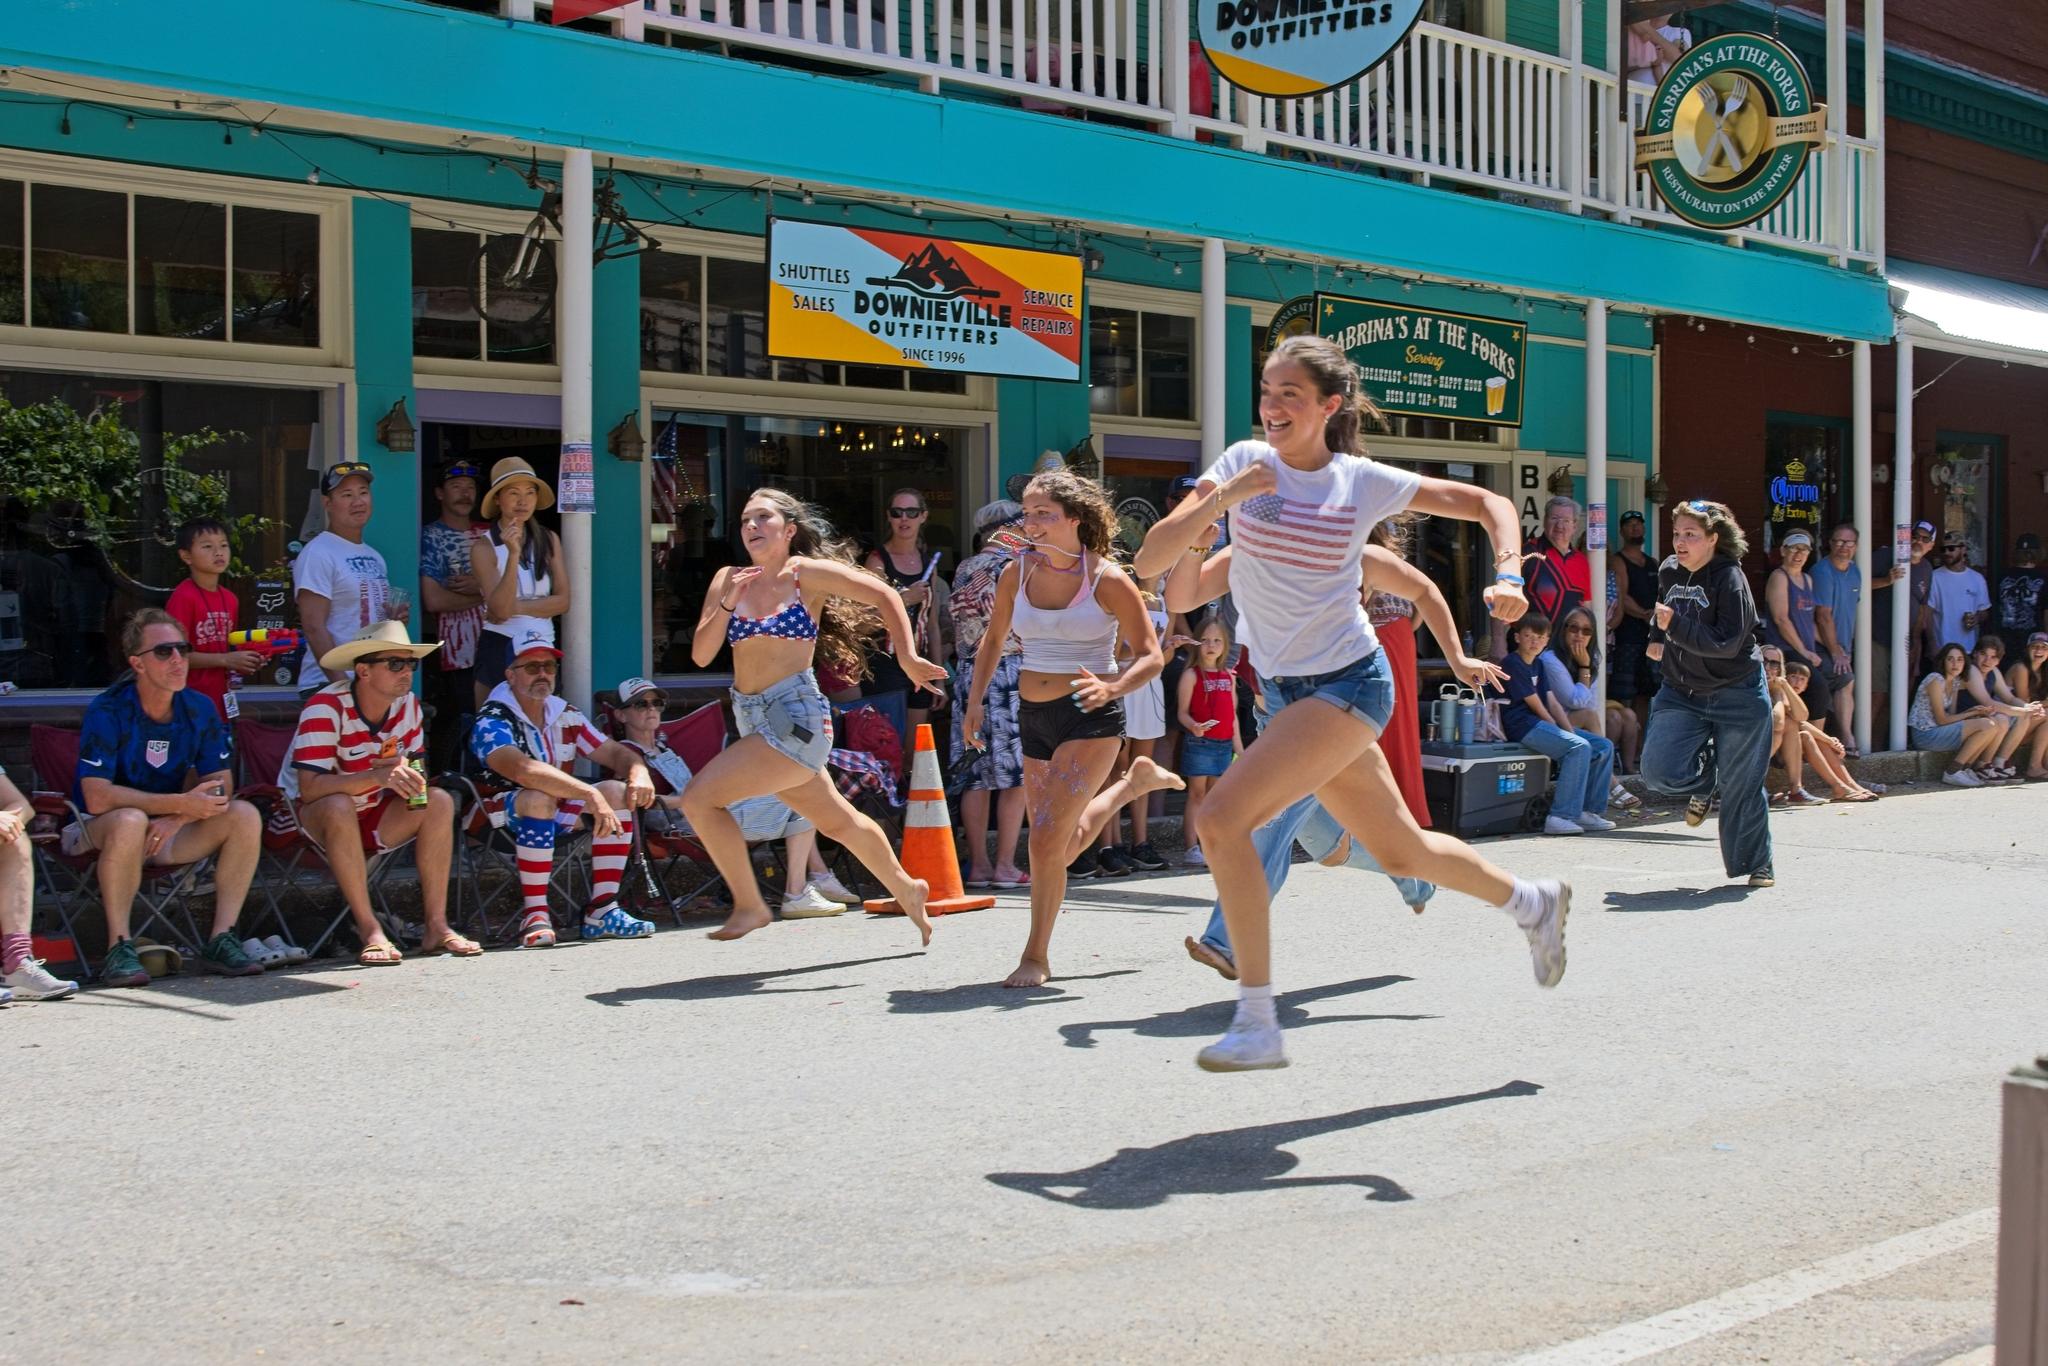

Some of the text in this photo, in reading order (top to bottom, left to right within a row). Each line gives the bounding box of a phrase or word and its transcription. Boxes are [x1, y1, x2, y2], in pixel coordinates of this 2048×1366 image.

[1231, 4, 1392, 49] OUTFITTERS
[1657, 45, 1801, 129] SABRINA'S AT THE FORKS
[1662, 153, 1793, 214] RESTAURANT ON THE RIVER
[779, 262, 850, 285] SHUTTLES
[793, 294, 835, 313] SALES
[854, 290, 1011, 328] DOWNIEVILLE
[1023, 289, 1074, 308] SERVICE
[868, 319, 998, 345] OUTFITTERS
[1020, 317, 1074, 336] REPAIRS
[902, 347, 966, 364] SINCE 1996
[1405, 345, 1446, 372] Serving
[1413, 316, 1432, 340] AT
[1437, 319, 1467, 351] THE
[1471, 332, 1516, 380] FORKS
[1360, 366, 1482, 392] BREAKFAST LUNCH HAPPY HOUR
[1385, 389, 1457, 409] BEER ON TAP WINE
[1771, 476, 1819, 507] Corona
[1786, 504, 1808, 518] Extra
[257, 620, 284, 630] DEALER
